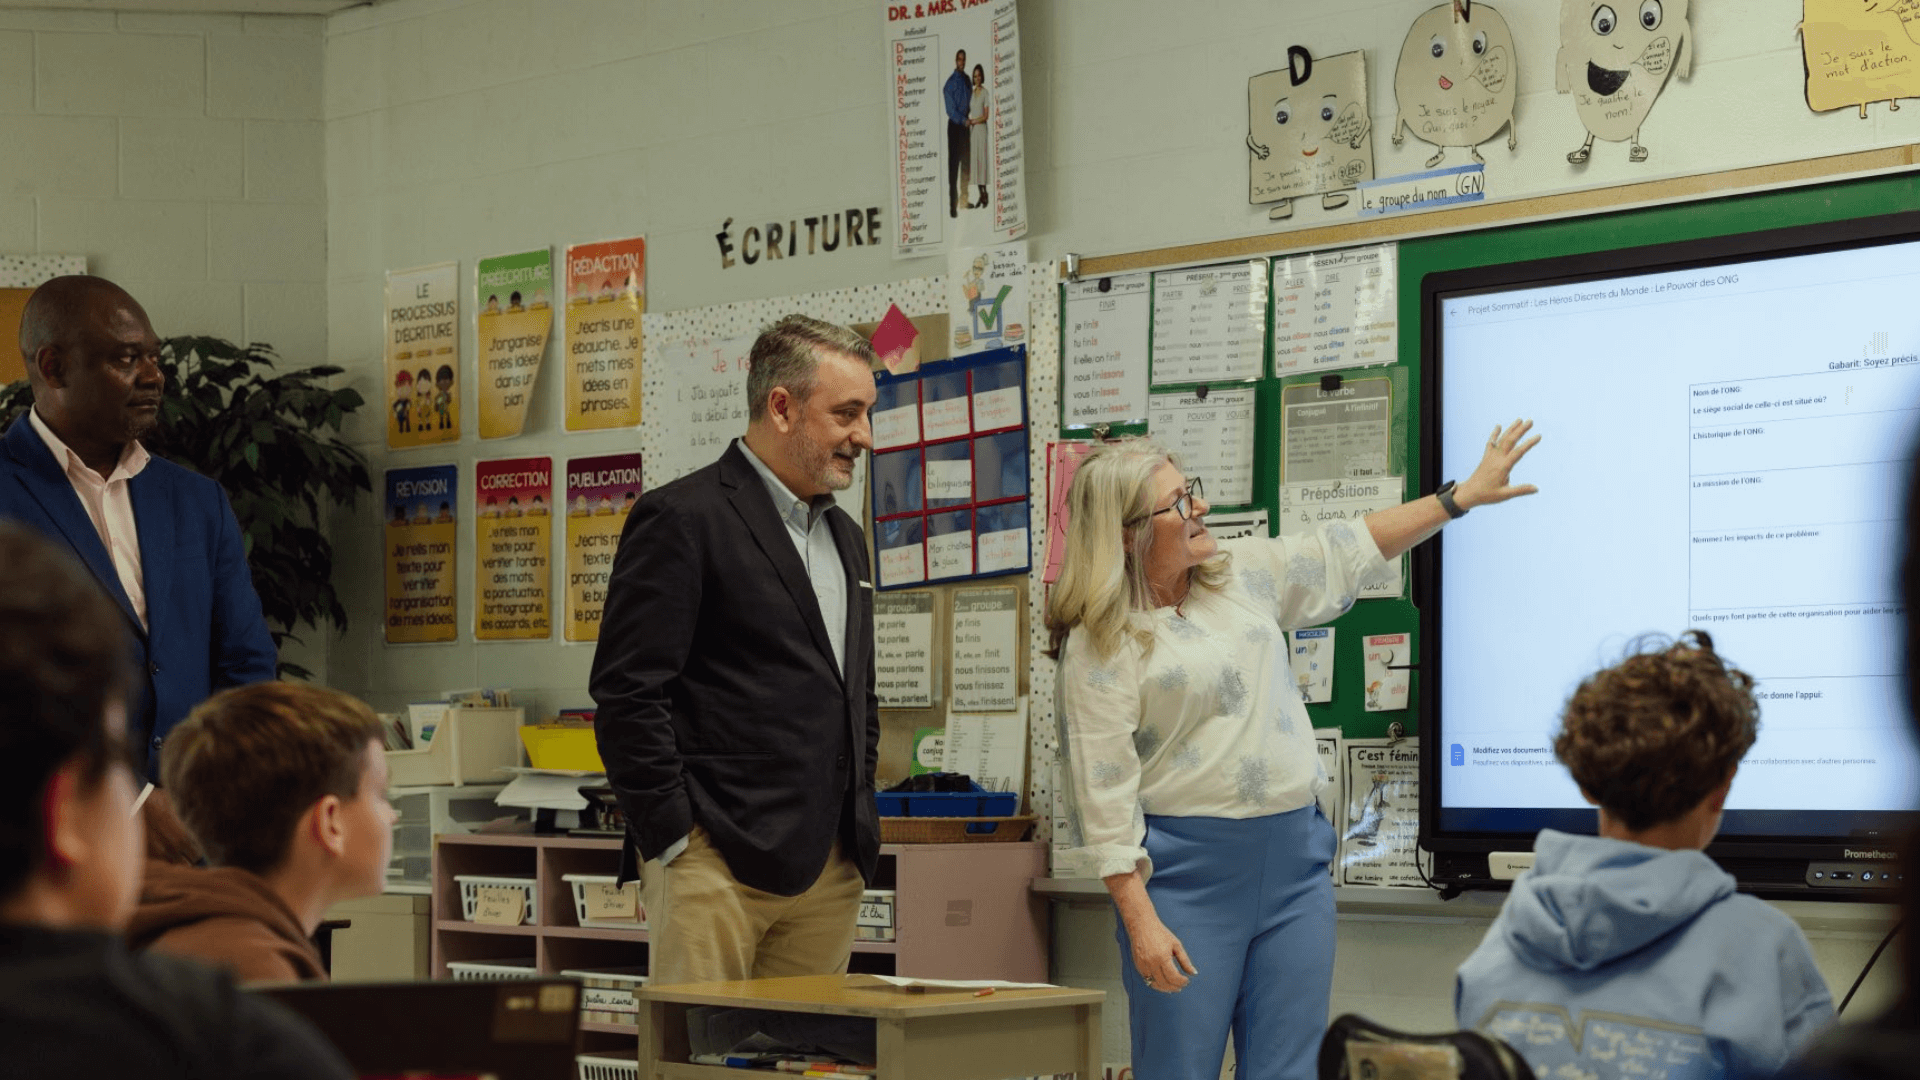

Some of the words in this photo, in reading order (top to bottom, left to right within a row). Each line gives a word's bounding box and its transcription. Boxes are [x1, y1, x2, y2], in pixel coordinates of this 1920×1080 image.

[888, 6, 911, 21] DR.
[915, 4, 925, 18] &
[928, 0, 957, 16] MRS.
[896, 43, 926, 54] Devenir
[1821, 52, 1839, 65] Je
[1849, 49, 1873, 60] suis
[1881, 41, 1892, 51] le
[896, 55, 925, 66] Revenir
[1287, 45, 1313, 87] D
[1826, 64, 1849, 78] mot
[897, 75, 926, 87] Monter
[897, 86, 925, 98] Rentrer
[1579, 95, 1592, 106] Je
[1598, 91, 1629, 106] qualifie
[1634, 88, 1643, 97] le
[898, 98, 920, 110] Sortir
[1605, 103, 1632, 120] nom!
[899, 115, 920, 127] Venir
[899, 127, 926, 138] Arriver
[899, 139, 925, 150] Naître
[899, 151, 938, 161] Descendre
[900, 163, 923, 174] Entrer
[900, 175, 936, 186] Retourner
[901, 188, 928, 198] Tomber
[902, 200, 924, 210] Rester
[1379, 195, 1410, 214] groupe
[1413, 187, 1424, 202] du
[1427, 189, 1447, 199] nom
[902, 221, 928, 233] Mourir
[715, 207, 882, 270] ÉCRITURE
[902, 233, 924, 244] Partir
[1357, 252, 1378, 262] groupe
[572, 253, 639, 276] RÉDACTION
[993, 260, 1016, 270] besoin
[417, 283, 429, 299] LE
[1468, 305, 1490, 316] Projet
[1491, 301, 1529, 312] Sommatif
[1534, 298, 1548, 307] Les
[1549, 295, 1573, 306] Héros
[1574, 291, 1607, 303] Discrets
[1608, 288, 1619, 298] du
[1620, 286, 1649, 297] Monde
[1655, 284, 1666, 294] Le
[1666, 280, 1698, 292] Pouvoir
[1699, 278, 1717, 288] des
[1717, 274, 1739, 286] ONG
[391, 301, 456, 323] PROCESSUS
[1099, 301, 1115, 310] FINIR
[395, 322, 453, 343] D'ÉCRITURE
[575, 320, 610, 336] J'écris
[613, 318, 635, 332] une
[1329, 327, 1350, 335] disons
[489, 333, 542, 353] J'organise
[572, 340, 622, 355] ébauche.
[625, 337, 638, 350] Je
[489, 358, 512, 371] mes
[515, 354, 540, 368] idées
[577, 361, 605, 374] mets
[608, 358, 633, 371] mes
[712, 350, 726, 372] Je
[1828, 359, 1862, 371] Gabarit:
[1863, 357, 1889, 369] Soyez
[1073, 372, 1090, 382] nous
[1092, 369, 1125, 380] finissons
[582, 379, 610, 393] idées
[613, 378, 628, 391] en
[710, 382, 740, 405] ajouté
[1073, 390, 1090, 400] vous
[1091, 387, 1120, 397] finissez
[504, 394, 525, 410] plan
[581, 398, 630, 414] phrases.
[692, 412, 702, 422] au
[705, 409, 728, 422] début
[732, 408, 742, 419] de
[1297, 407, 1326, 417] Conjugué
[481, 472, 548, 489] CORRECTION
[568, 468, 641, 488] PUBLICATION
[396, 478, 447, 497] RÉVISION
[928, 477, 972, 493] bilinguism
[1301, 484, 1380, 502] Prépositions
[489, 526, 499, 538] Je
[501, 526, 520, 537] relis
[522, 526, 539, 536] mon
[1692, 536, 1722, 544] Nommez
[1724, 534, 1735, 542] les
[1737, 533, 1764, 543] impacts
[1785, 529, 1819, 540] problème
[492, 541, 512, 551] texte
[514, 542, 535, 553] pour
[575, 534, 609, 548] J'écris
[392, 544, 407, 557] Je
[409, 544, 428, 556] relis
[432, 543, 450, 554] mon
[482, 555, 513, 568] vérifier
[583, 554, 610, 566] texte
[396, 560, 421, 573] texte
[424, 561, 445, 574] pour
[403, 576, 438, 591] vérifier
[571, 572, 607, 586] propre
[389, 615, 404, 627] de
[407, 615, 425, 627] mes
[956, 619, 963, 629] je
[964, 618, 981, 628] finis
[955, 634, 963, 643] tu
[964, 634, 981, 643] finis
[877, 665, 895, 673] nous
[895, 664, 924, 675] parlons
[955, 666, 973, 674] nous
[975, 664, 1010, 674] finissons
[877, 680, 894, 688] vous
[895, 680, 918, 690] parlez
[955, 682, 973, 691] vous
[974, 681, 1004, 690] finissez
[1391, 684, 1406, 694] elle
[1770, 691, 1793, 699] donne
[1357, 750, 1385, 761] C'est
[1390, 750, 1418, 762] fémin
[1472, 746, 1501, 754] Modifiez
[1844, 848, 1898, 860] Promethean
